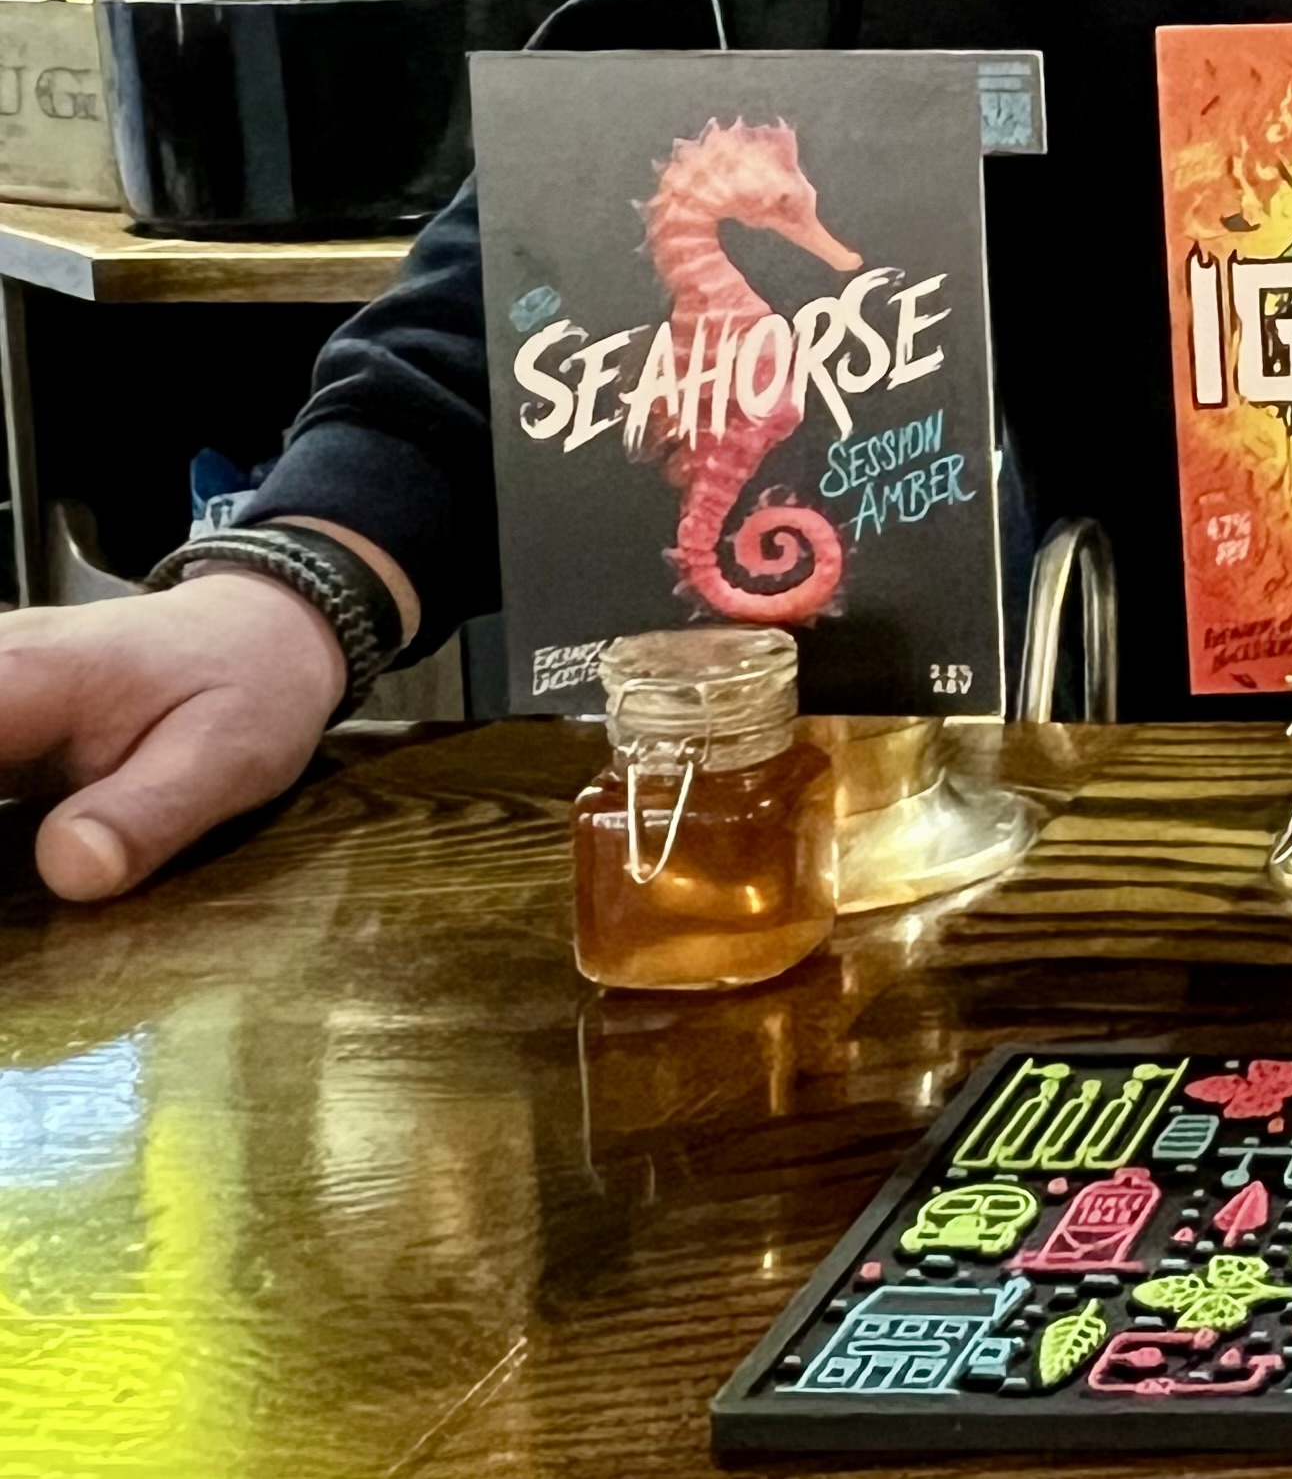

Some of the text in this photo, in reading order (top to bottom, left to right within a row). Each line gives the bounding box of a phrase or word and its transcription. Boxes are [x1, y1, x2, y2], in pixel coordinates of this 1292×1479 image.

[513, 267, 951, 454] SEAHORSE
[819, 410, 945, 497] SESSION
[853, 451, 976, 541] AMBER
